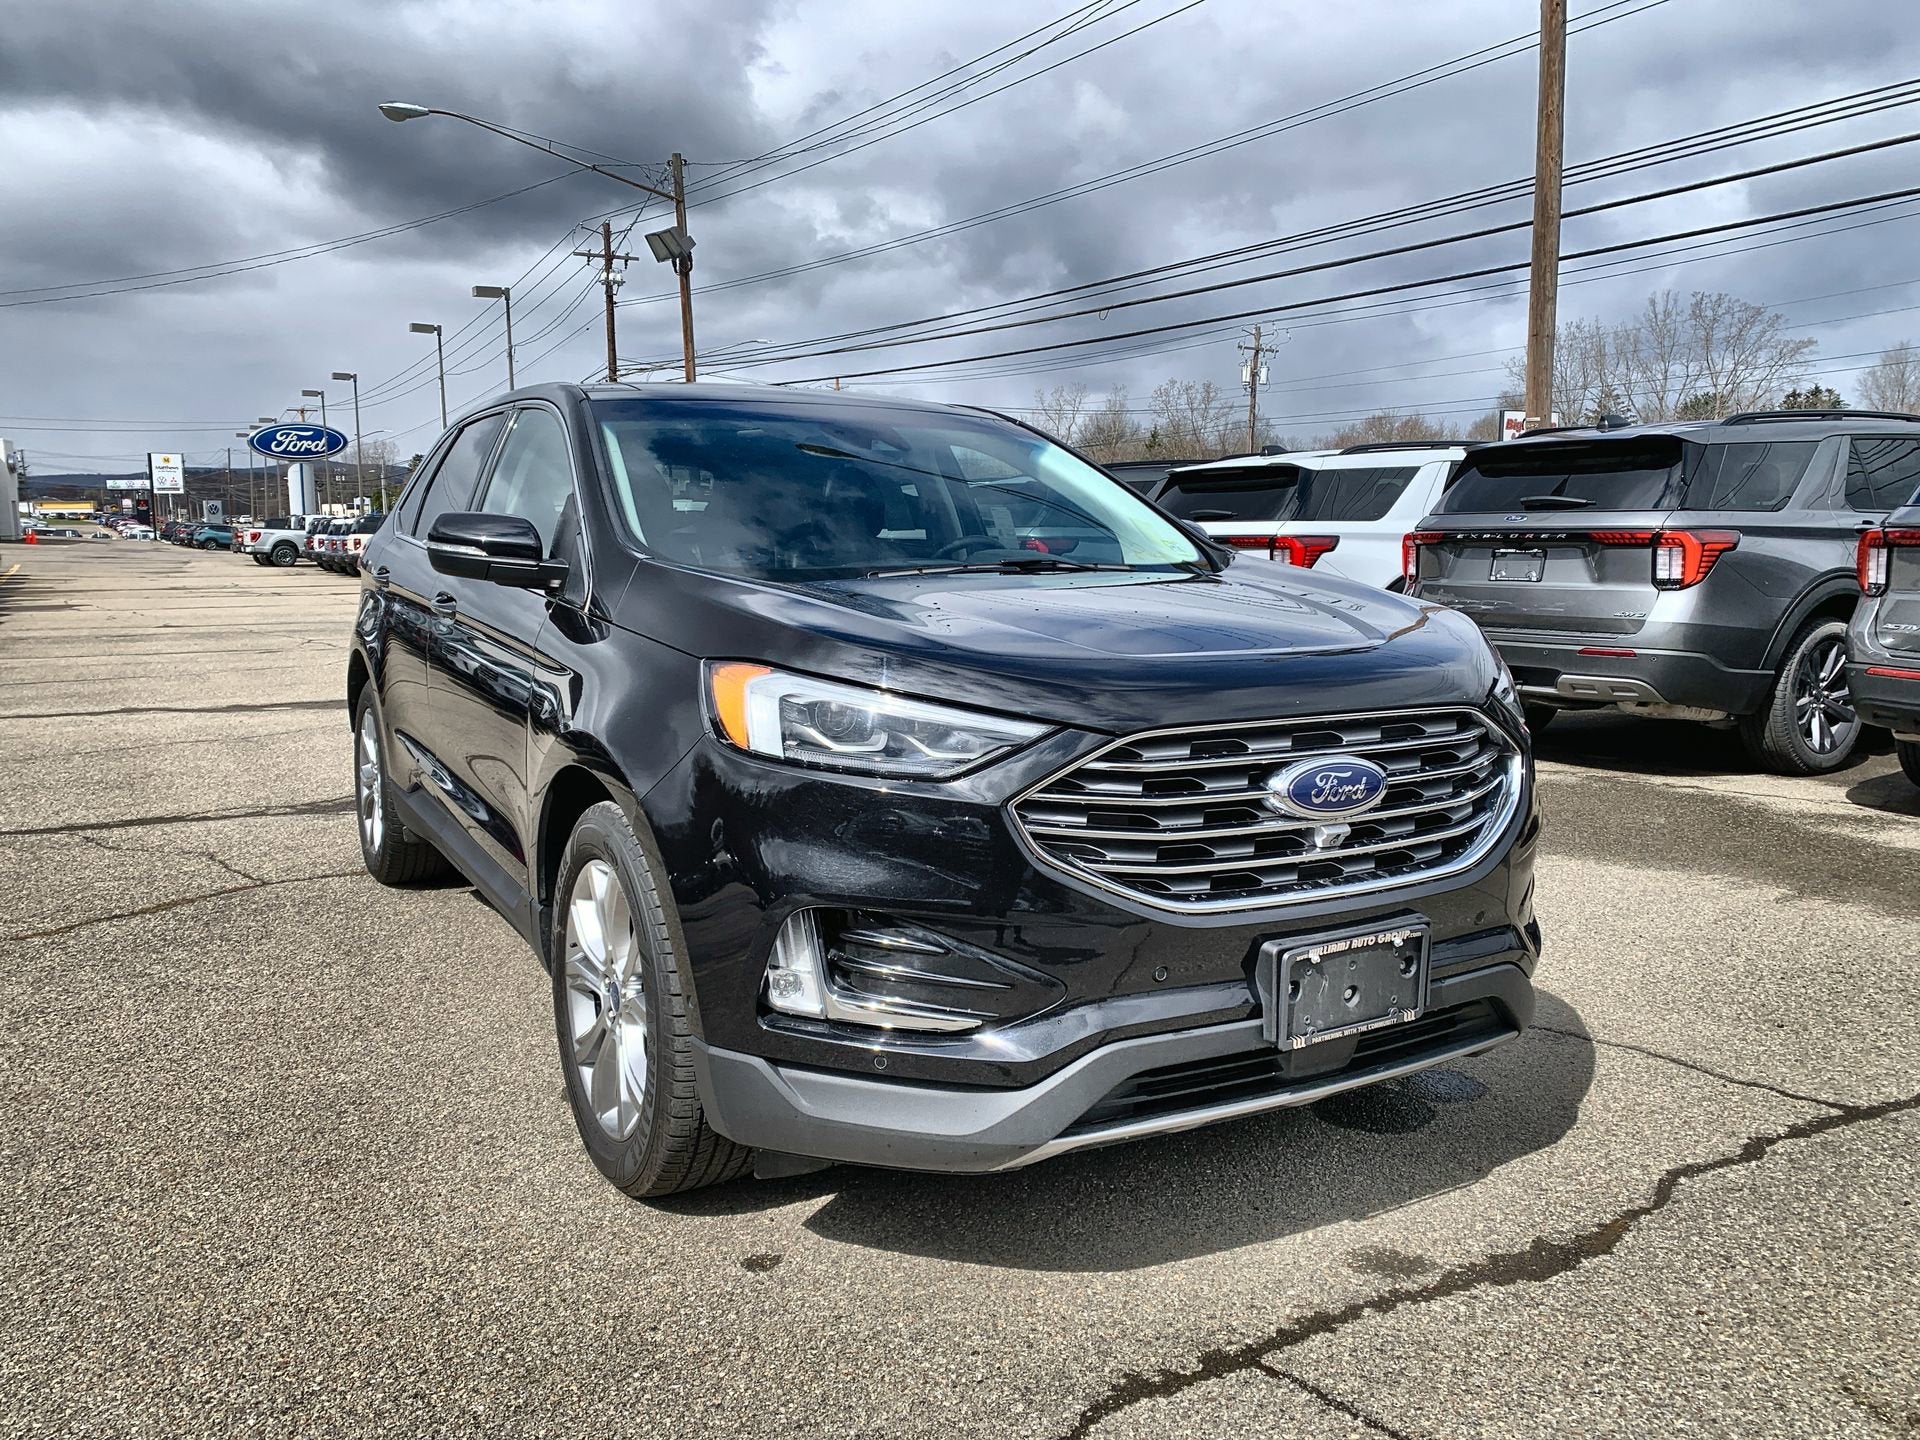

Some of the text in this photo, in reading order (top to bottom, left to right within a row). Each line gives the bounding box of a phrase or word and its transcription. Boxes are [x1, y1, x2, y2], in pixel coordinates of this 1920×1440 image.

[271, 430, 328, 452] Ford
[1311, 771, 1367, 804] Ford
[1351, 936, 1376, 949] AUTO
[1343, 1028, 1357, 1036] WITH
[1358, 1025, 1368, 1033] THE
